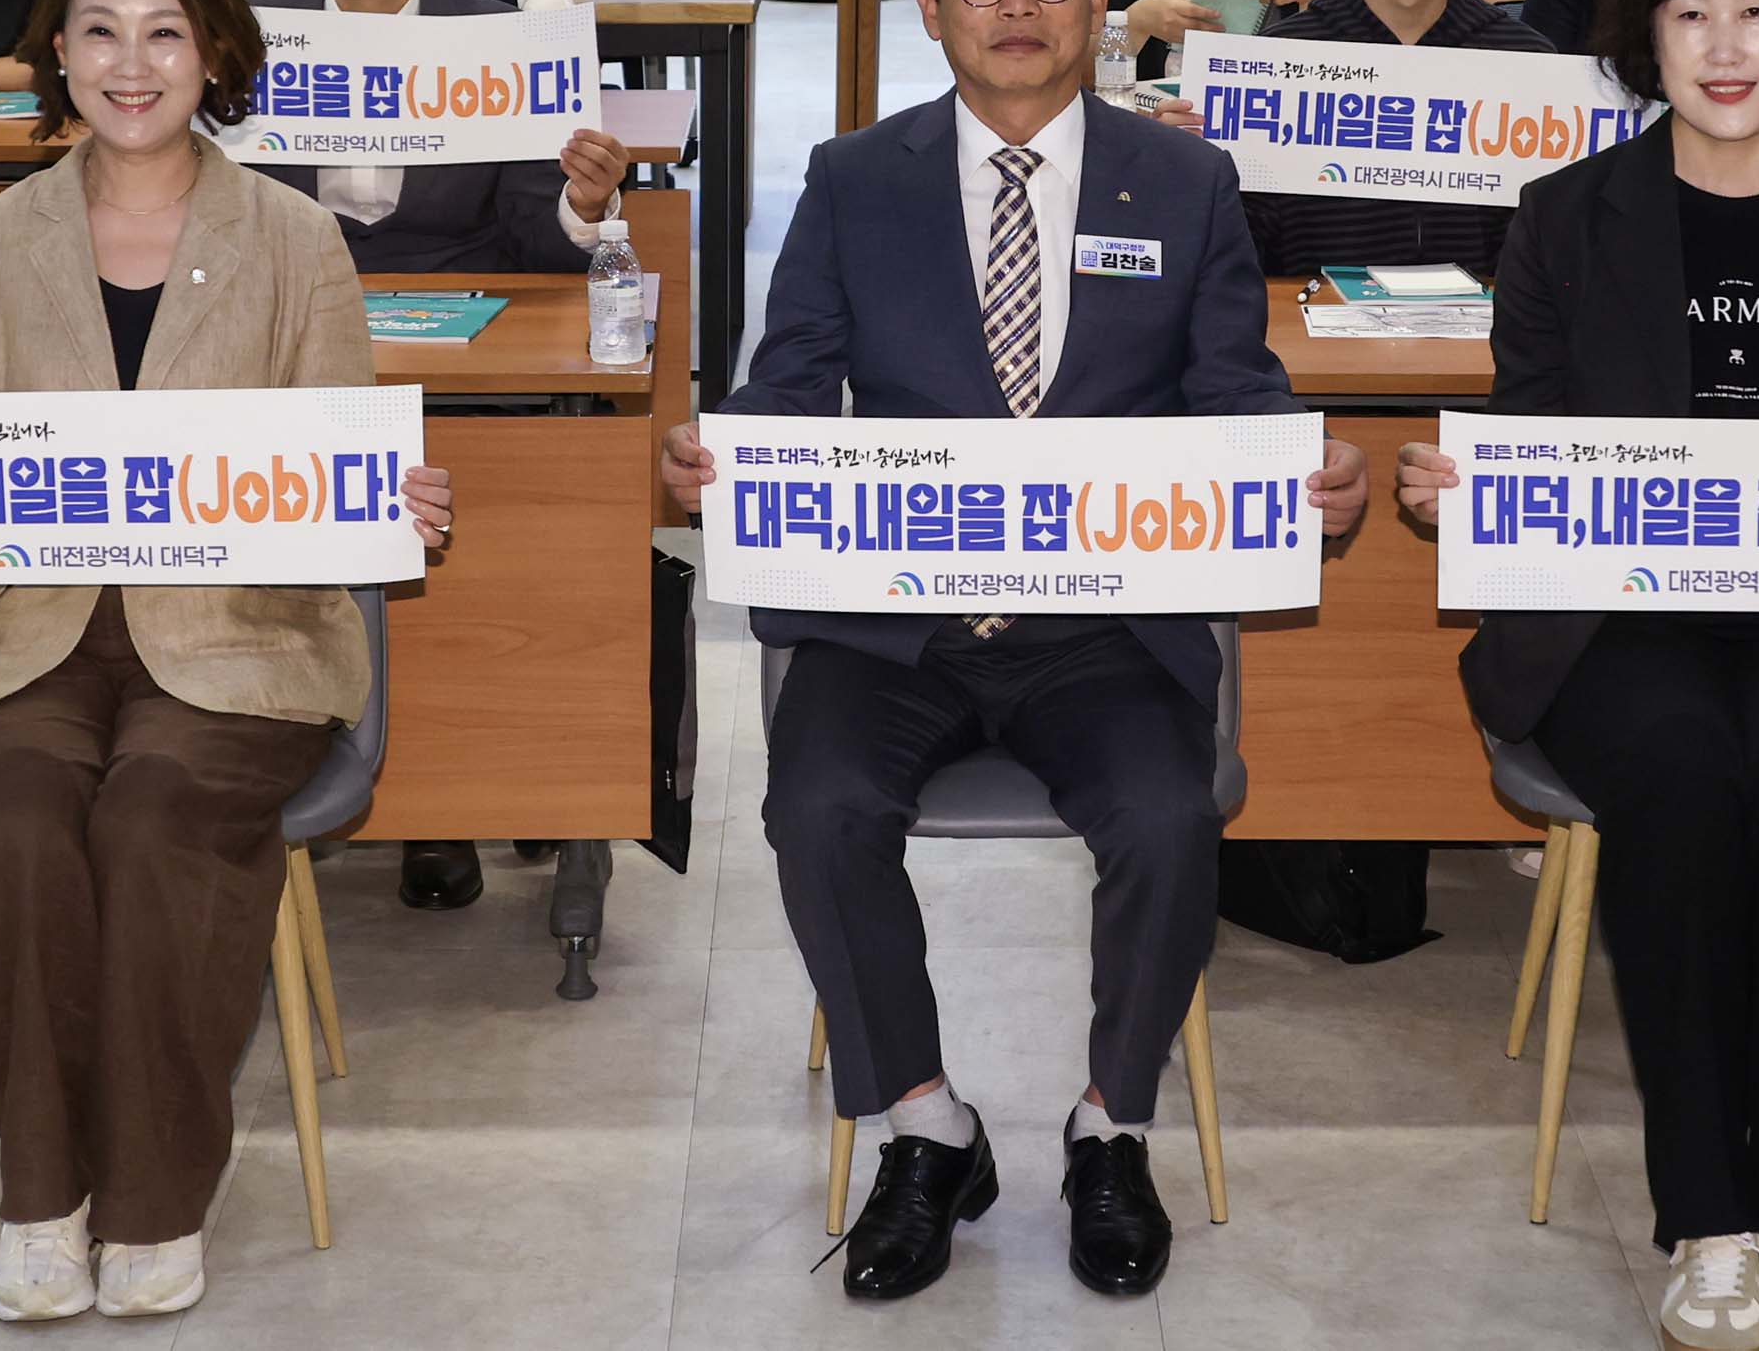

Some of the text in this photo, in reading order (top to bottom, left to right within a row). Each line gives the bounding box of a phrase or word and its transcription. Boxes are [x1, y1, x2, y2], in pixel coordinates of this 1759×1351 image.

[260, 33, 310, 49] 심입니다
[1315, 63, 1378, 82] 중심입니다
[363, 57, 582, 119] 잡(Job)다!
[295, 134, 445, 152] 대전광역시 대덕구
[1354, 166, 1501, 191] 대전광역시 대덕구
[1101, 252, 1156, 272] 김찬술
[873, 447, 955, 469] 중심입니다
[1611, 444, 1693, 463] 중심입니다
[123, 451, 401, 523] 잡(Job)다!
[1022, 478, 1298, 552] 잡(Job)다!
[40, 546, 228, 567] 대전광역시 대덕구
[935, 574, 1123, 596] 대전광역시 대덕구
